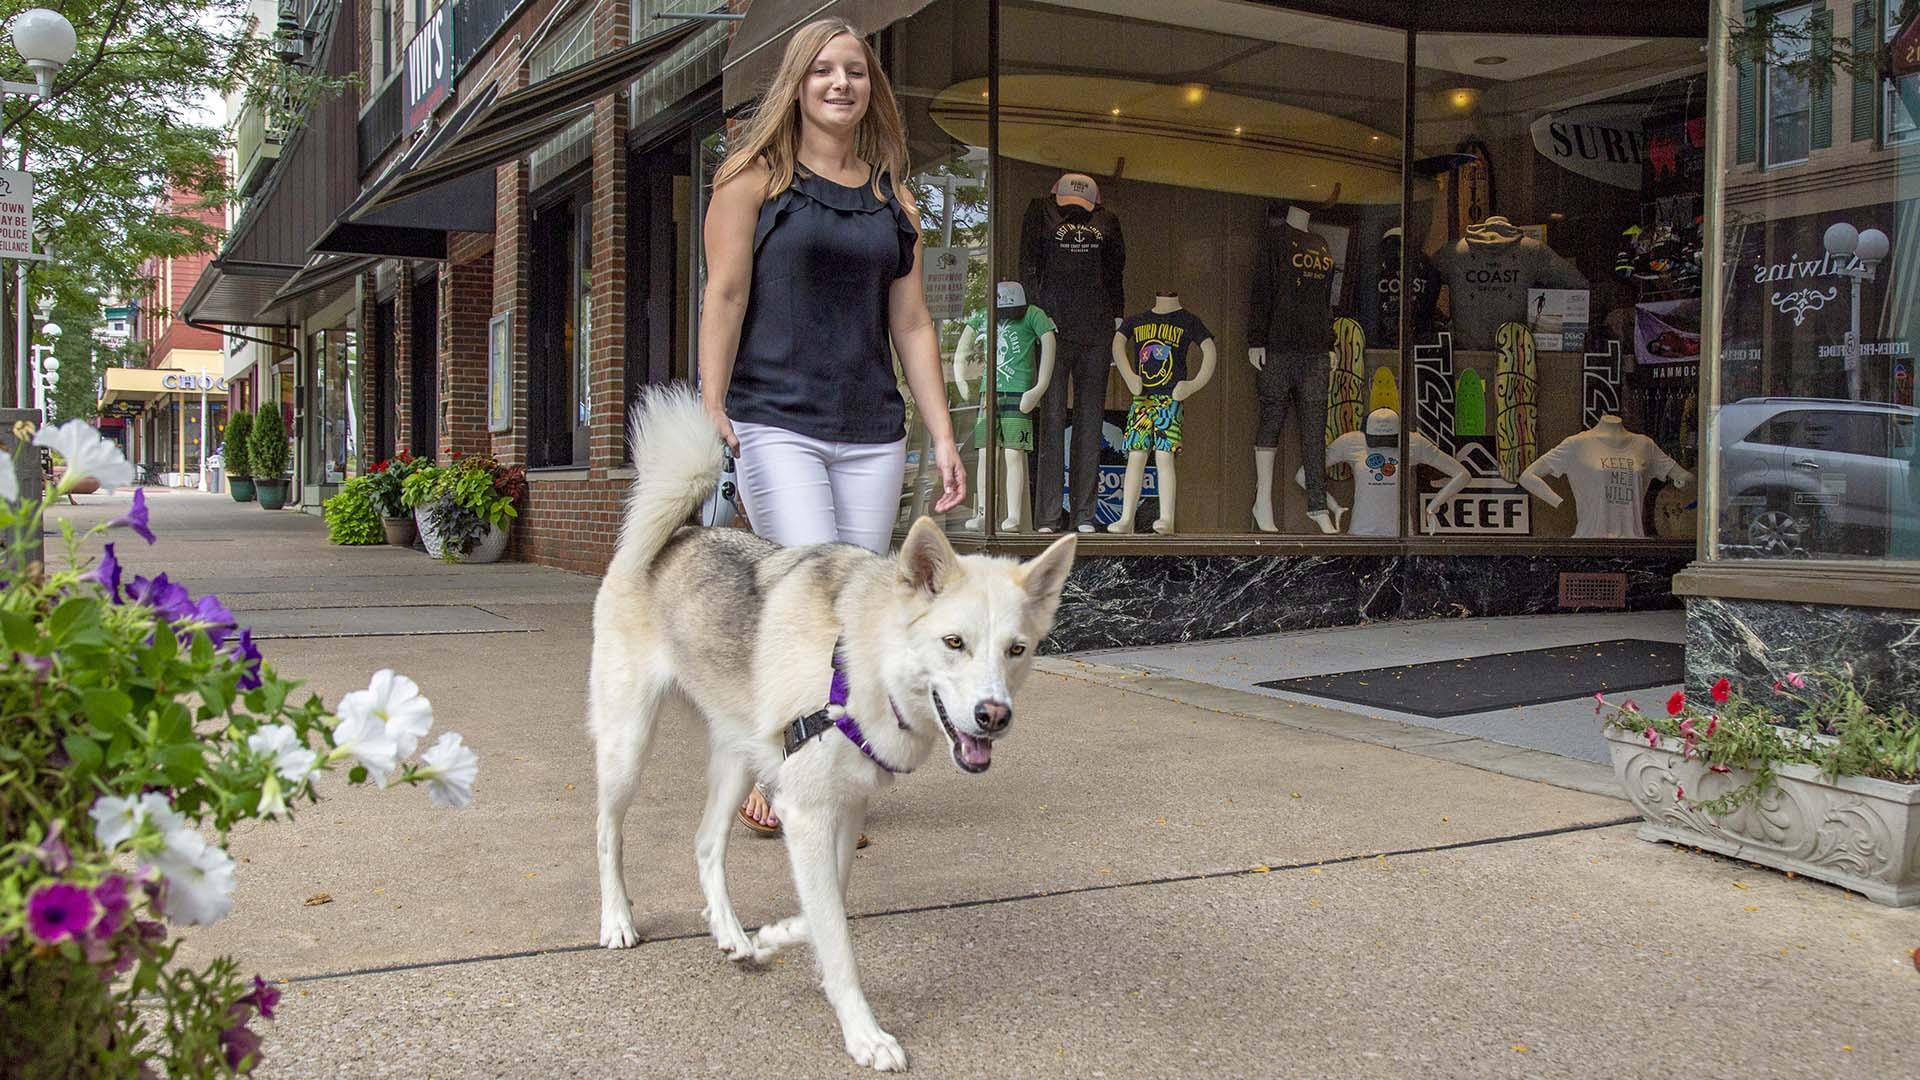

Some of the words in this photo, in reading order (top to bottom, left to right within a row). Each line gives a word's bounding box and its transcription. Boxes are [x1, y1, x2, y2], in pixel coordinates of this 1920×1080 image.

[0, 215, 13, 226] AY
[15, 217, 27, 227] BE
[1292, 253, 1335, 271] COAST
[1466, 270, 1520, 283] COAST
[1378, 278, 1428, 293] COST
[1134, 323, 1157, 343] THIRD
[1158, 323, 1184, 345] COAST
[1425, 499, 1524, 528] REEF
